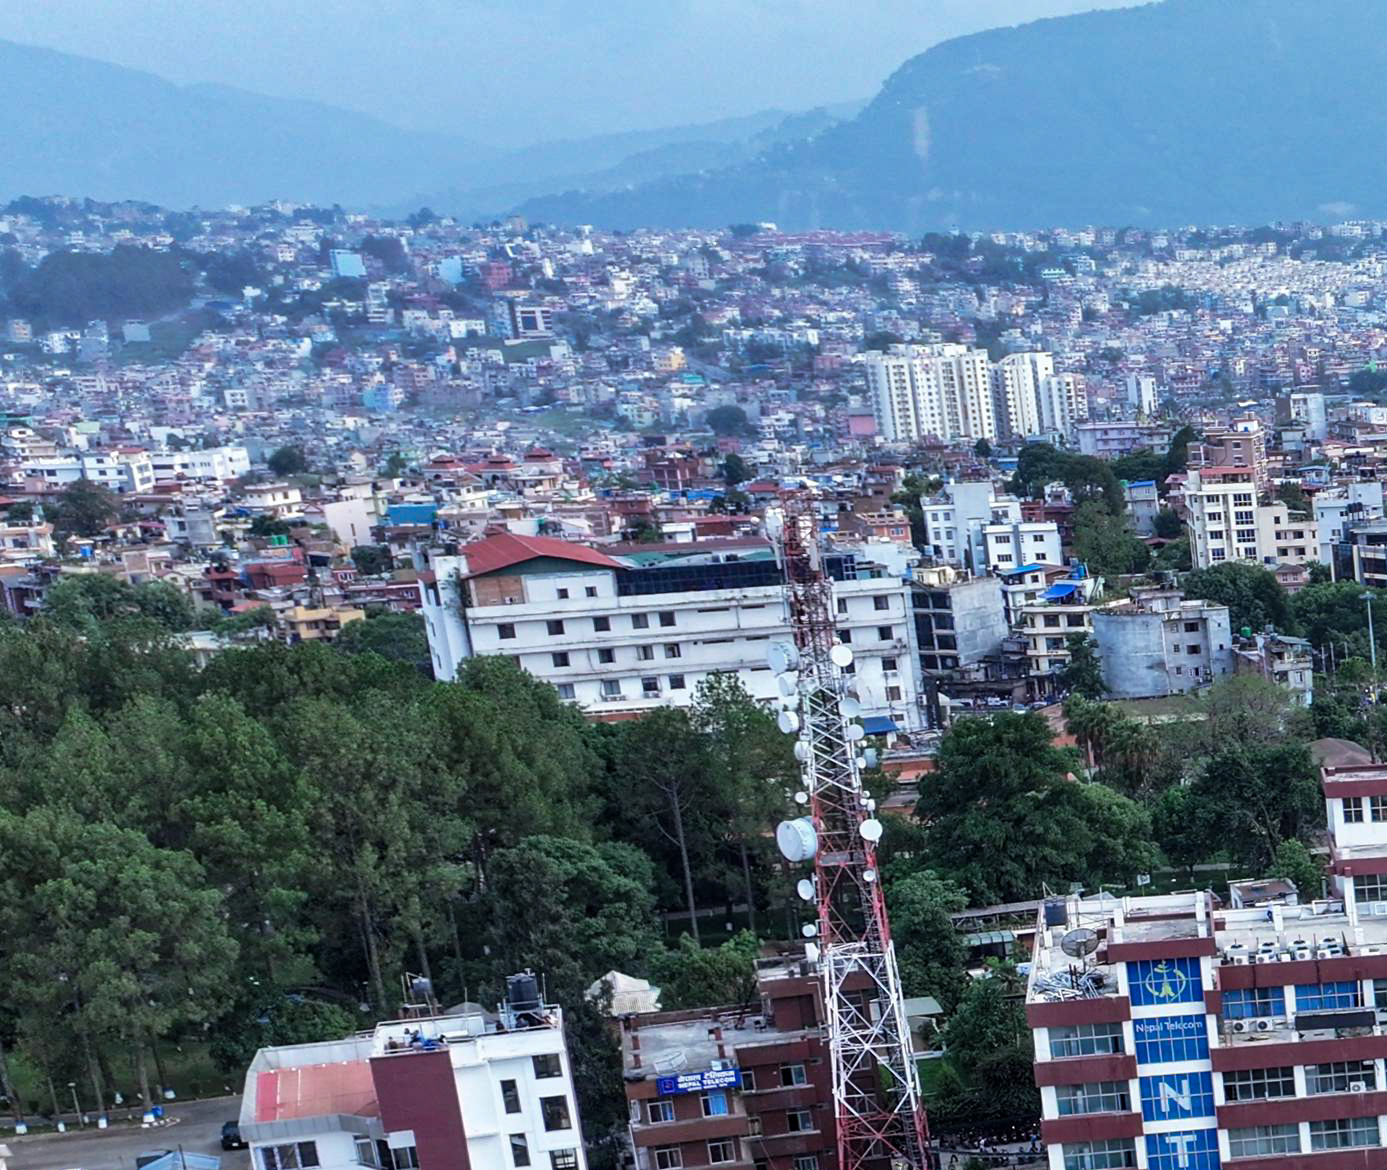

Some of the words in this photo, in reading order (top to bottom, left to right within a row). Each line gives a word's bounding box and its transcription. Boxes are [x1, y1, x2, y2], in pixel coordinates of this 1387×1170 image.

[1136, 1021, 1163, 1033] Nepal
[1164, 1020, 1203, 1031] Telecom
[1159, 1080, 1192, 1113] N
[1165, 1134, 1197, 1169] T
